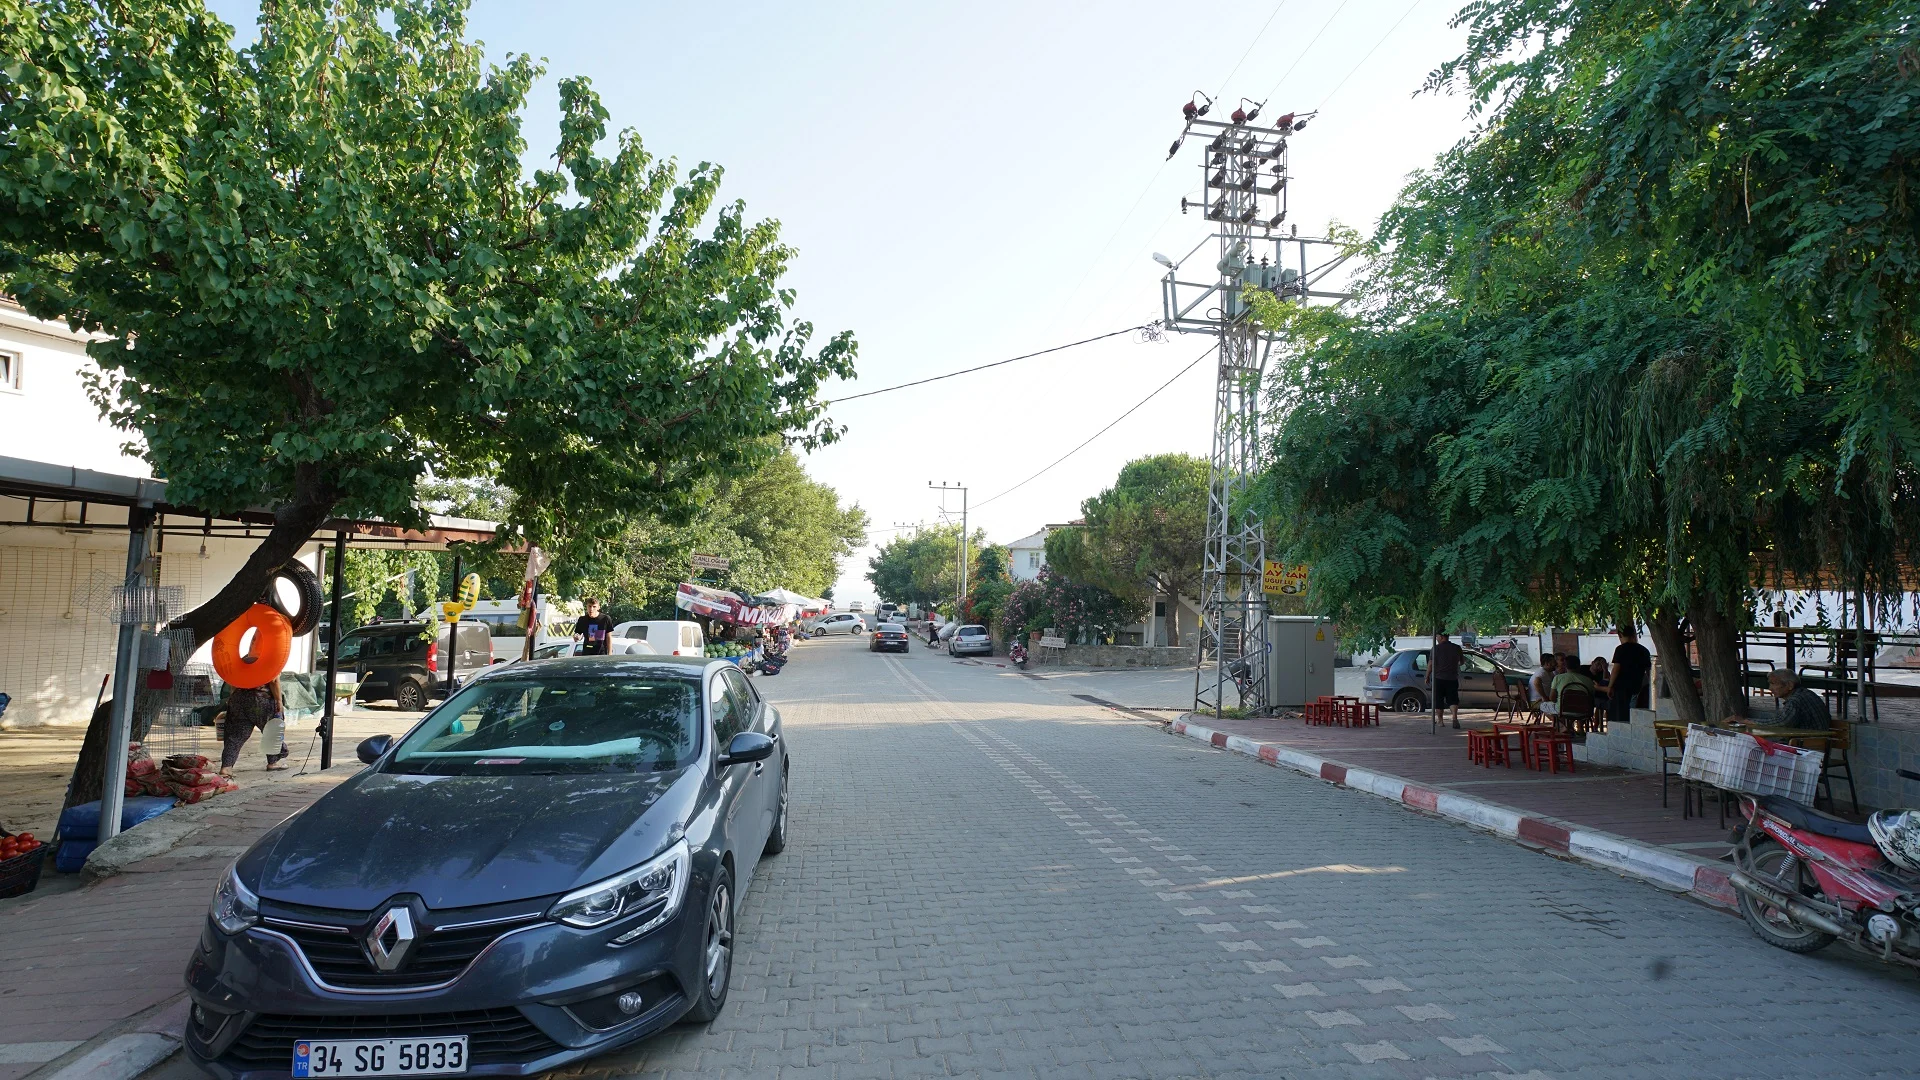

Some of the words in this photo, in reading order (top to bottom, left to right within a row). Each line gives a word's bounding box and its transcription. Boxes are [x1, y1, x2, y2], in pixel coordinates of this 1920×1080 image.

[1266, 569, 1307, 579] AYRAN
[313, 1045, 342, 1073] 34
[354, 1045, 385, 1072] SG
[398, 1041, 463, 1071] 5833
[296, 1061, 308, 1070] TR
